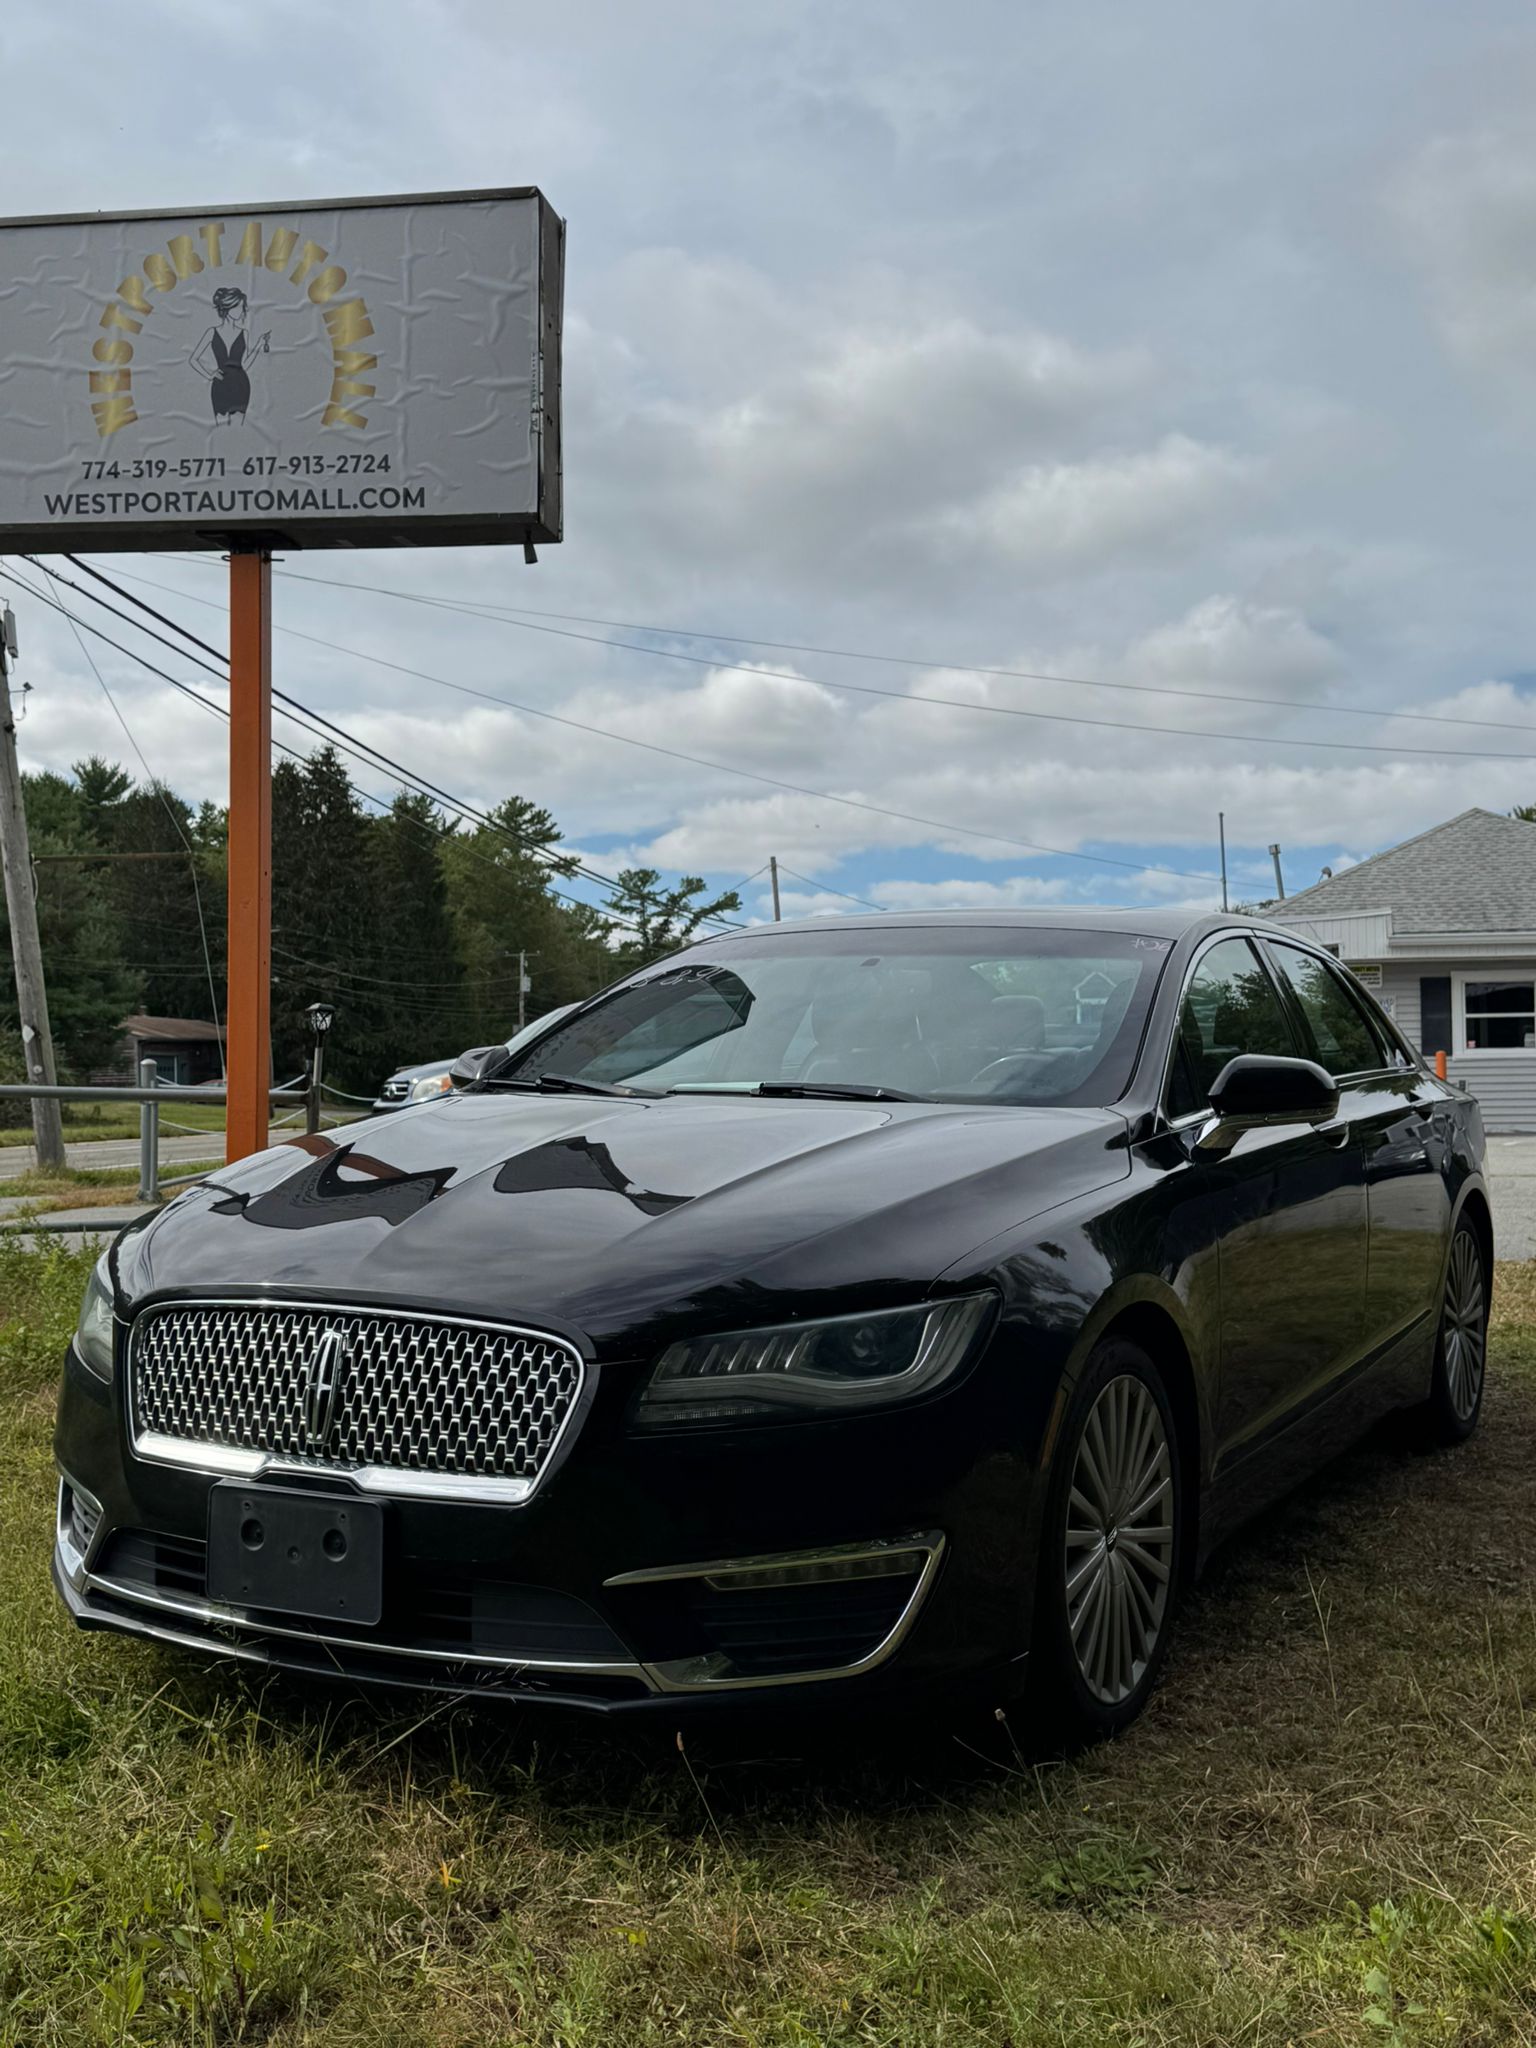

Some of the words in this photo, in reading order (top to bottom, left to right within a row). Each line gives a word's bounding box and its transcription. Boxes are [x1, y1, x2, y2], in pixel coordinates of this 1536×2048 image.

[81, 458, 226, 480] 774-319-5771
[242, 454, 392, 477] 617-913-2724
[44, 486, 426, 516] WESTPORTAUTOMALL.COM
